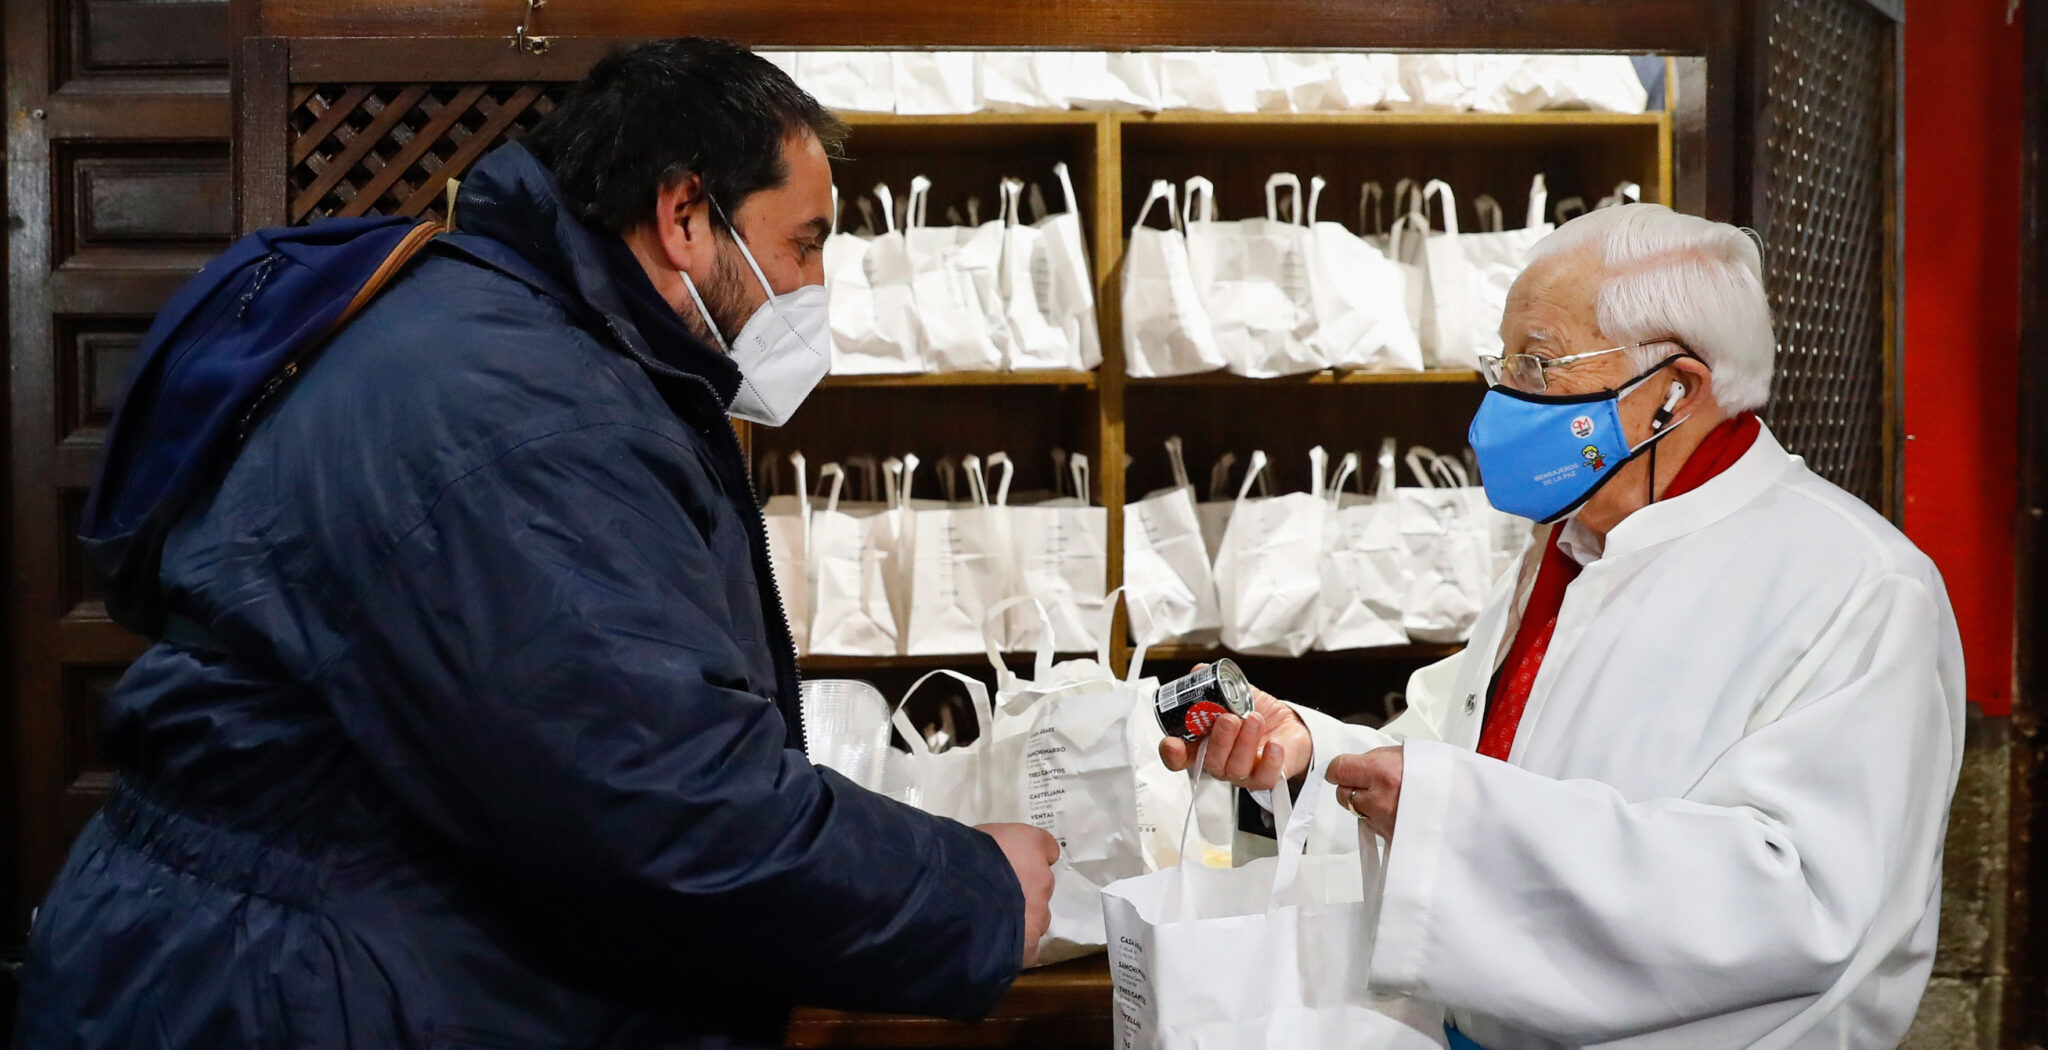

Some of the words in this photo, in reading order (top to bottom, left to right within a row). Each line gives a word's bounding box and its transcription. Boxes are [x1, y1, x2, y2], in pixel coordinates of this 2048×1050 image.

[1534, 463, 1579, 481] MENSAJEROS
[1563, 471, 1576, 480] PAZ
[1029, 789, 1066, 800] CASTELLANA
[1030, 811, 1054, 820] VENTAS
